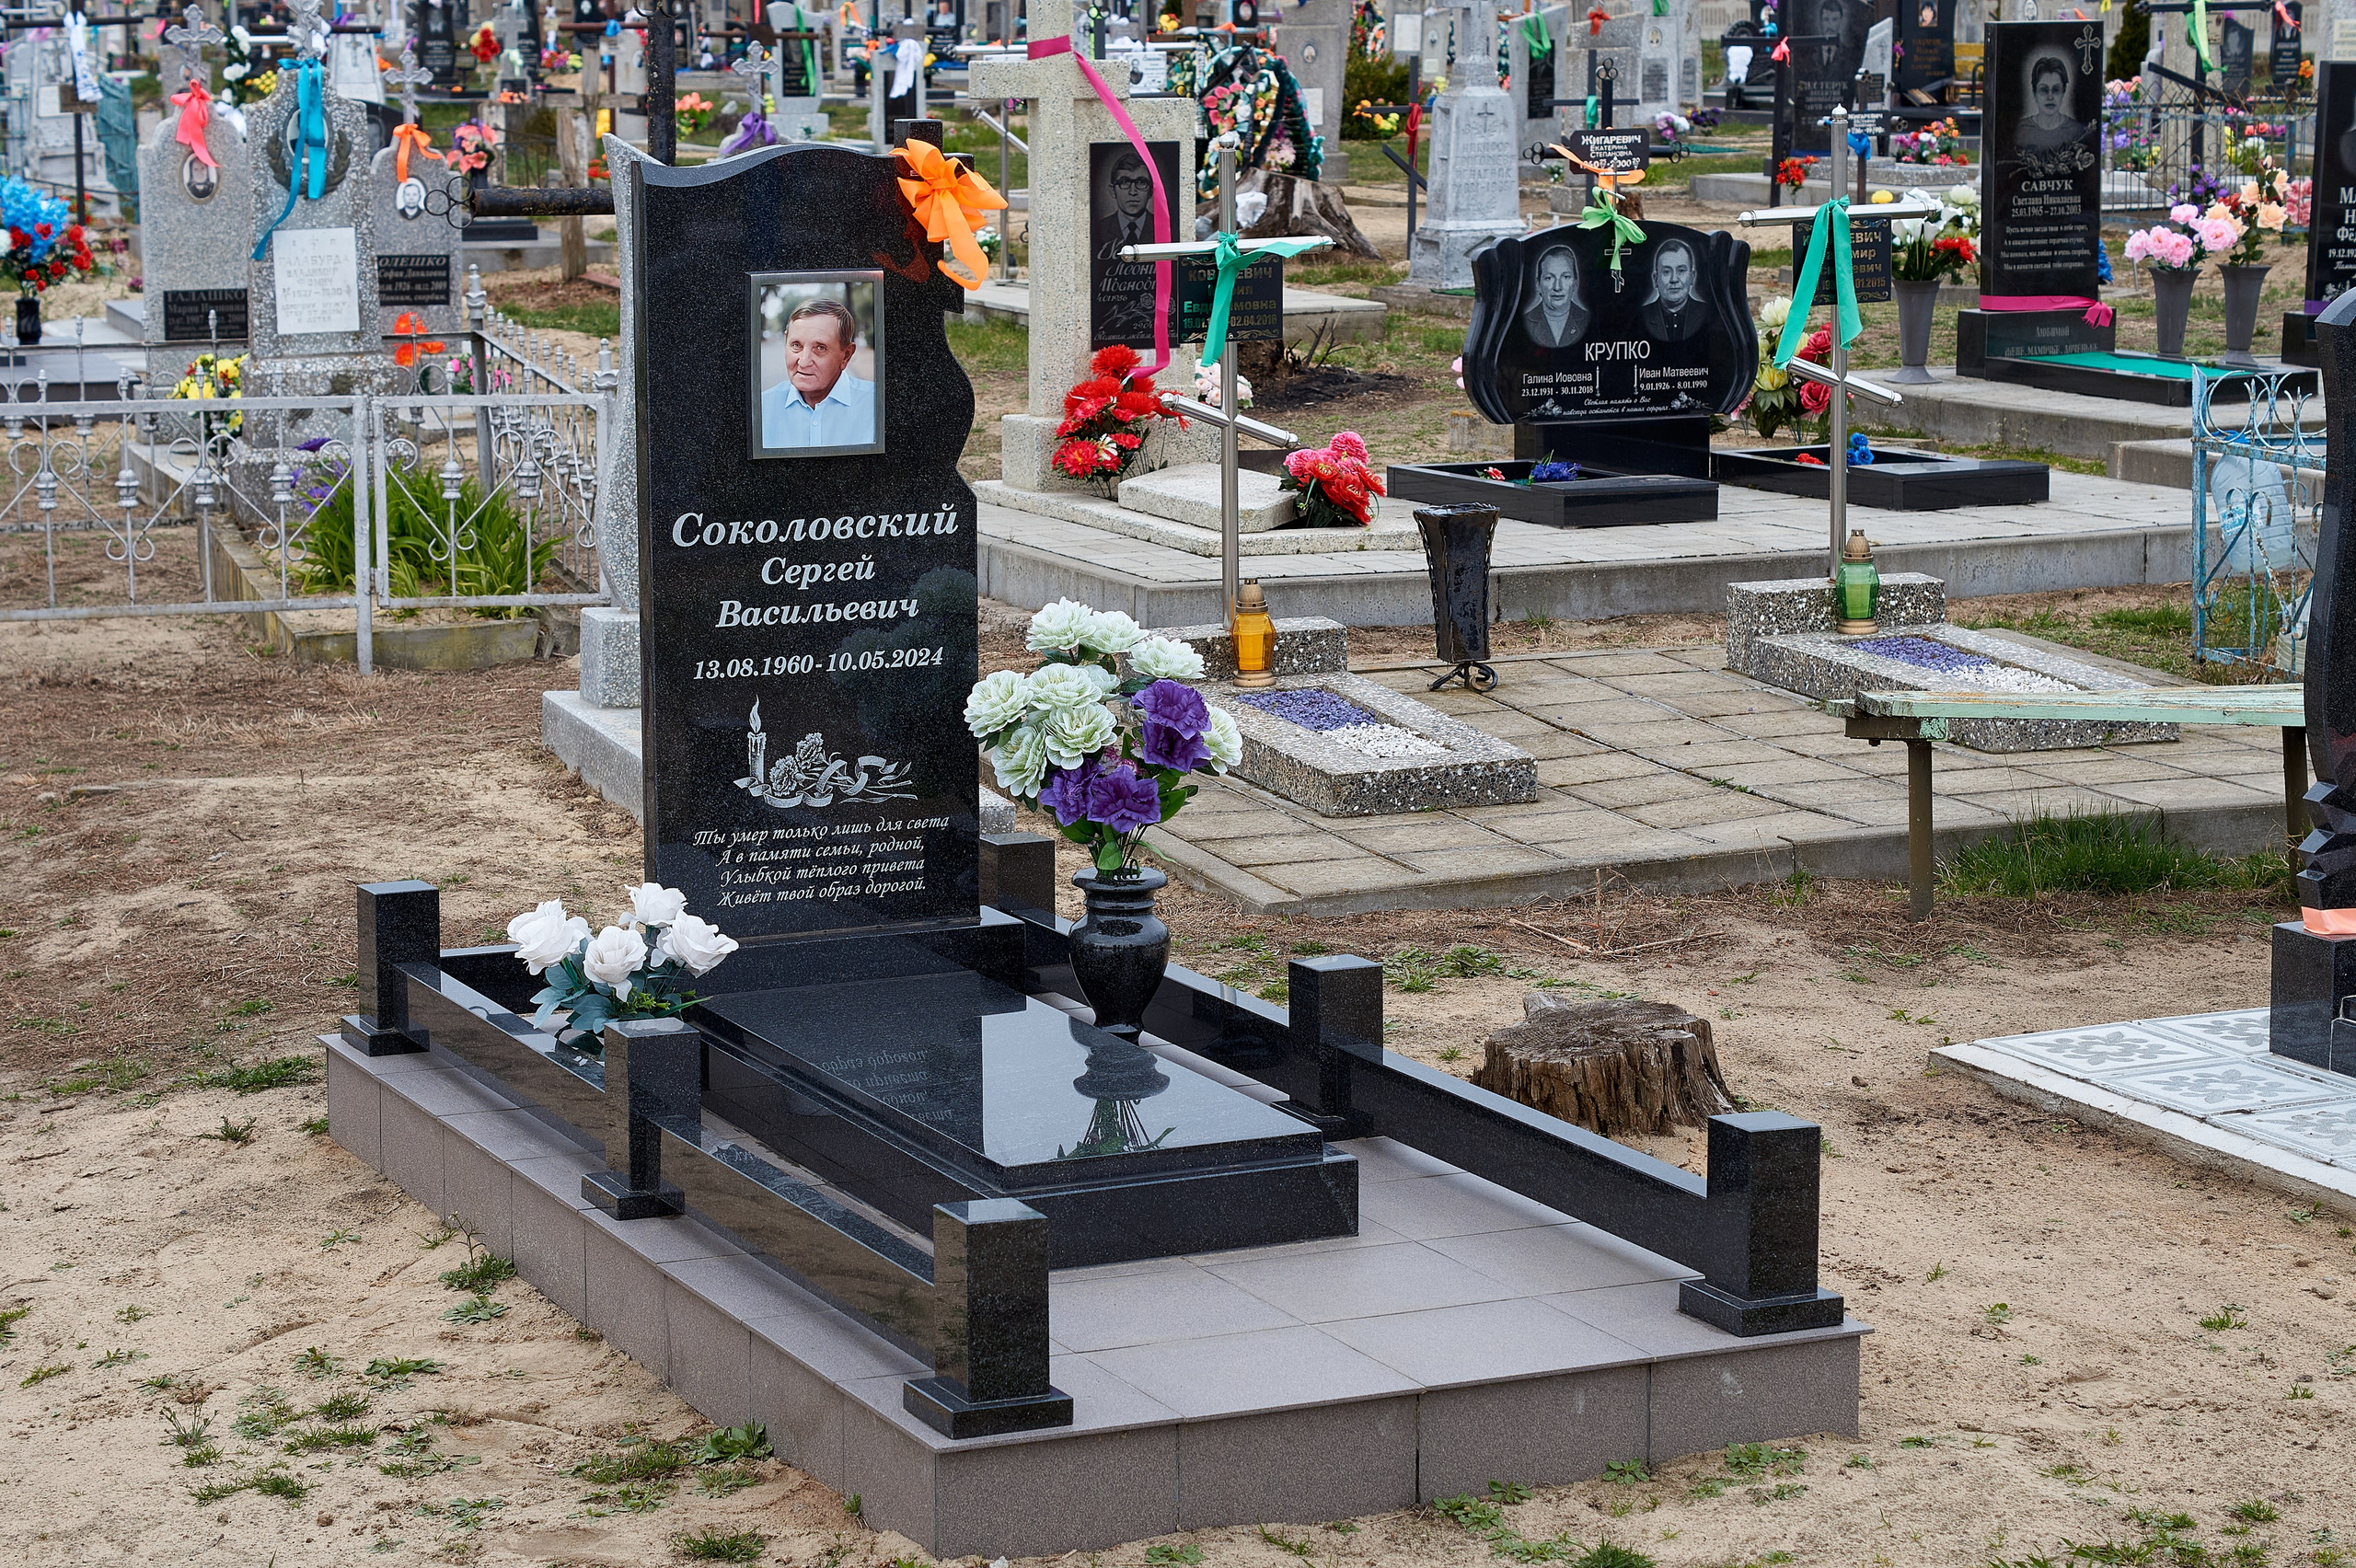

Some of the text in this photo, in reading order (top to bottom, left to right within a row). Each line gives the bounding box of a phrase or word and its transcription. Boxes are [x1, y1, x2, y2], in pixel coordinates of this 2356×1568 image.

[1581, 135, 1641, 145] ЖИГАРЕВИЧ
[2021, 179, 2073, 191] САВЧУК
[2013, 194, 2081, 206] Светлана Николаевна
[2012, 205, 2043, 217] 25.03.1965
[278, 255, 350, 267] ГАЛАБУРДА
[378, 257, 446, 267] ОЛЕШКО
[1188, 267, 1272, 282] КОВЕВИЧ
[167, 290, 246, 302] ГАЛАШКО
[1585, 340, 1651, 362] КРУПКО
[1523, 372, 1592, 384] Галина Иововна
[1639, 366, 1709, 378] Иван Матвеевич
[1521, 387, 1553, 397] 23.12.1931
[1561, 386, 1594, 396] 30.11.2018
[1639, 382, 1670, 391] 9.01.1926
[1677, 380, 1708, 389] 8.01.1990
[672, 503, 958, 547] Соколовский
[761, 554, 875, 590] Сергей
[715, 599, 919, 628] Васильевич
[692, 816, 950, 847] Ты умер только лишь для света
[716, 835, 925, 867] А в памяти семьи, родной,
[721, 859, 925, 888] Улыбкой тёплого привета
[717, 877, 927, 908] Живёт твой образ дорогой.
